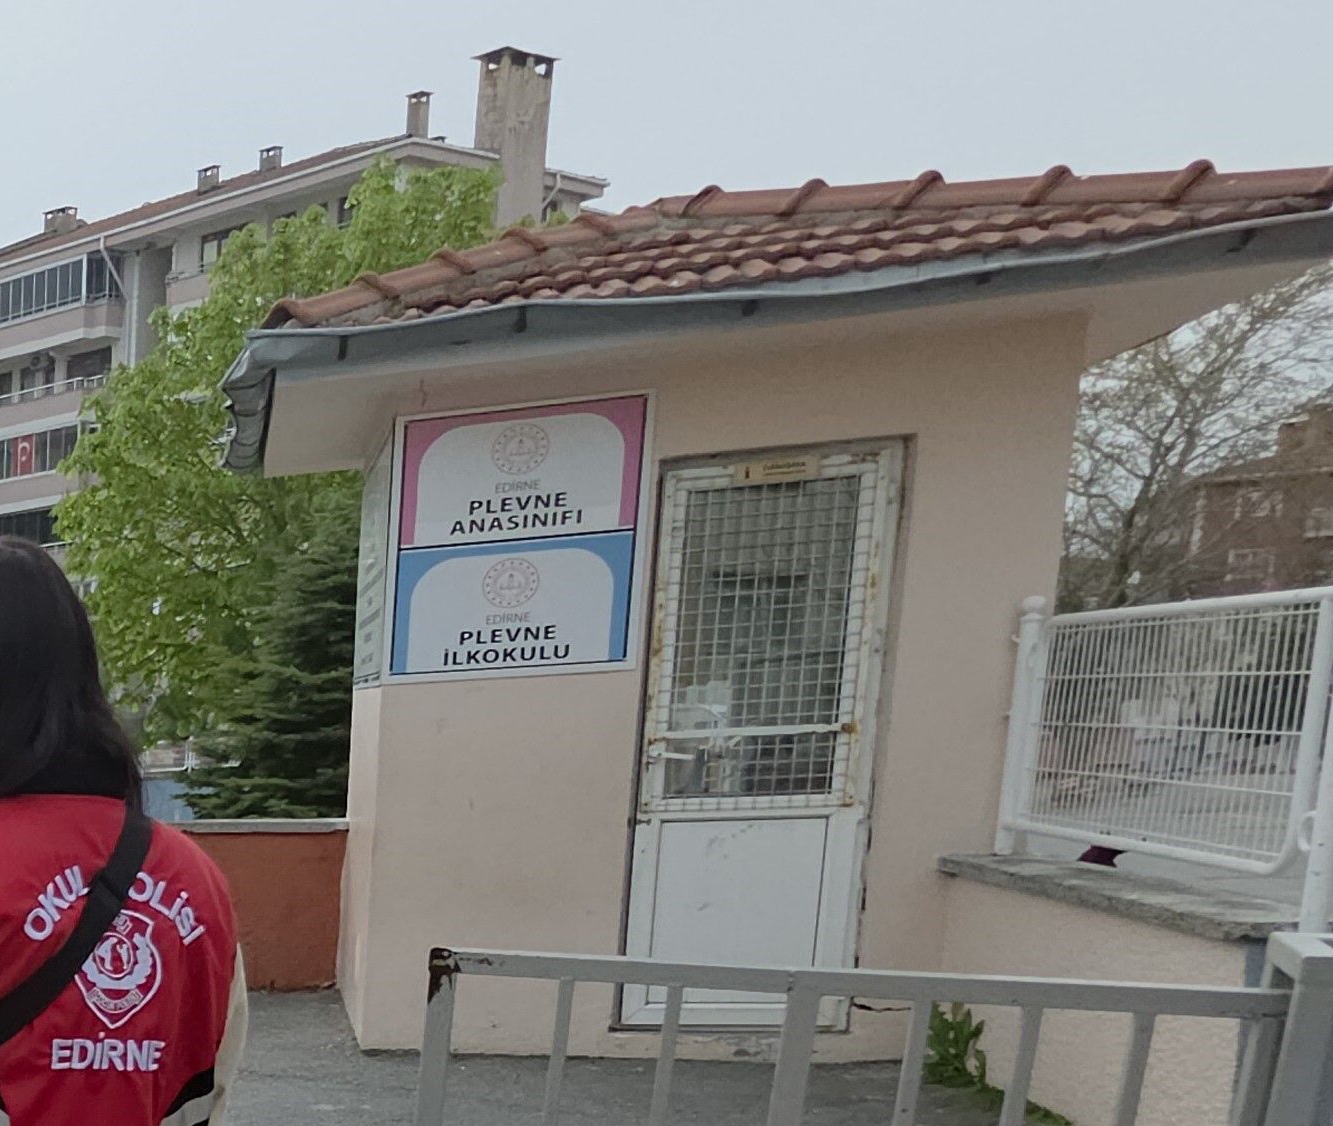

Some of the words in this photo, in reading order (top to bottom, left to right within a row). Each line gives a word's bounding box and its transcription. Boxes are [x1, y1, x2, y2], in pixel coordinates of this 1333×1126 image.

[495, 479, 541, 494] EDİRNE
[469, 492, 567, 515] PLEVNE
[450, 509, 583, 535] ANASINIFI
[485, 611, 531, 625] EDİRNE
[459, 625, 556, 645] PLEVNE
[443, 644, 570, 666] İLKOKULU
[24, 865, 90, 941] OKUL
[51, 1031, 166, 1072] EDİRNE
